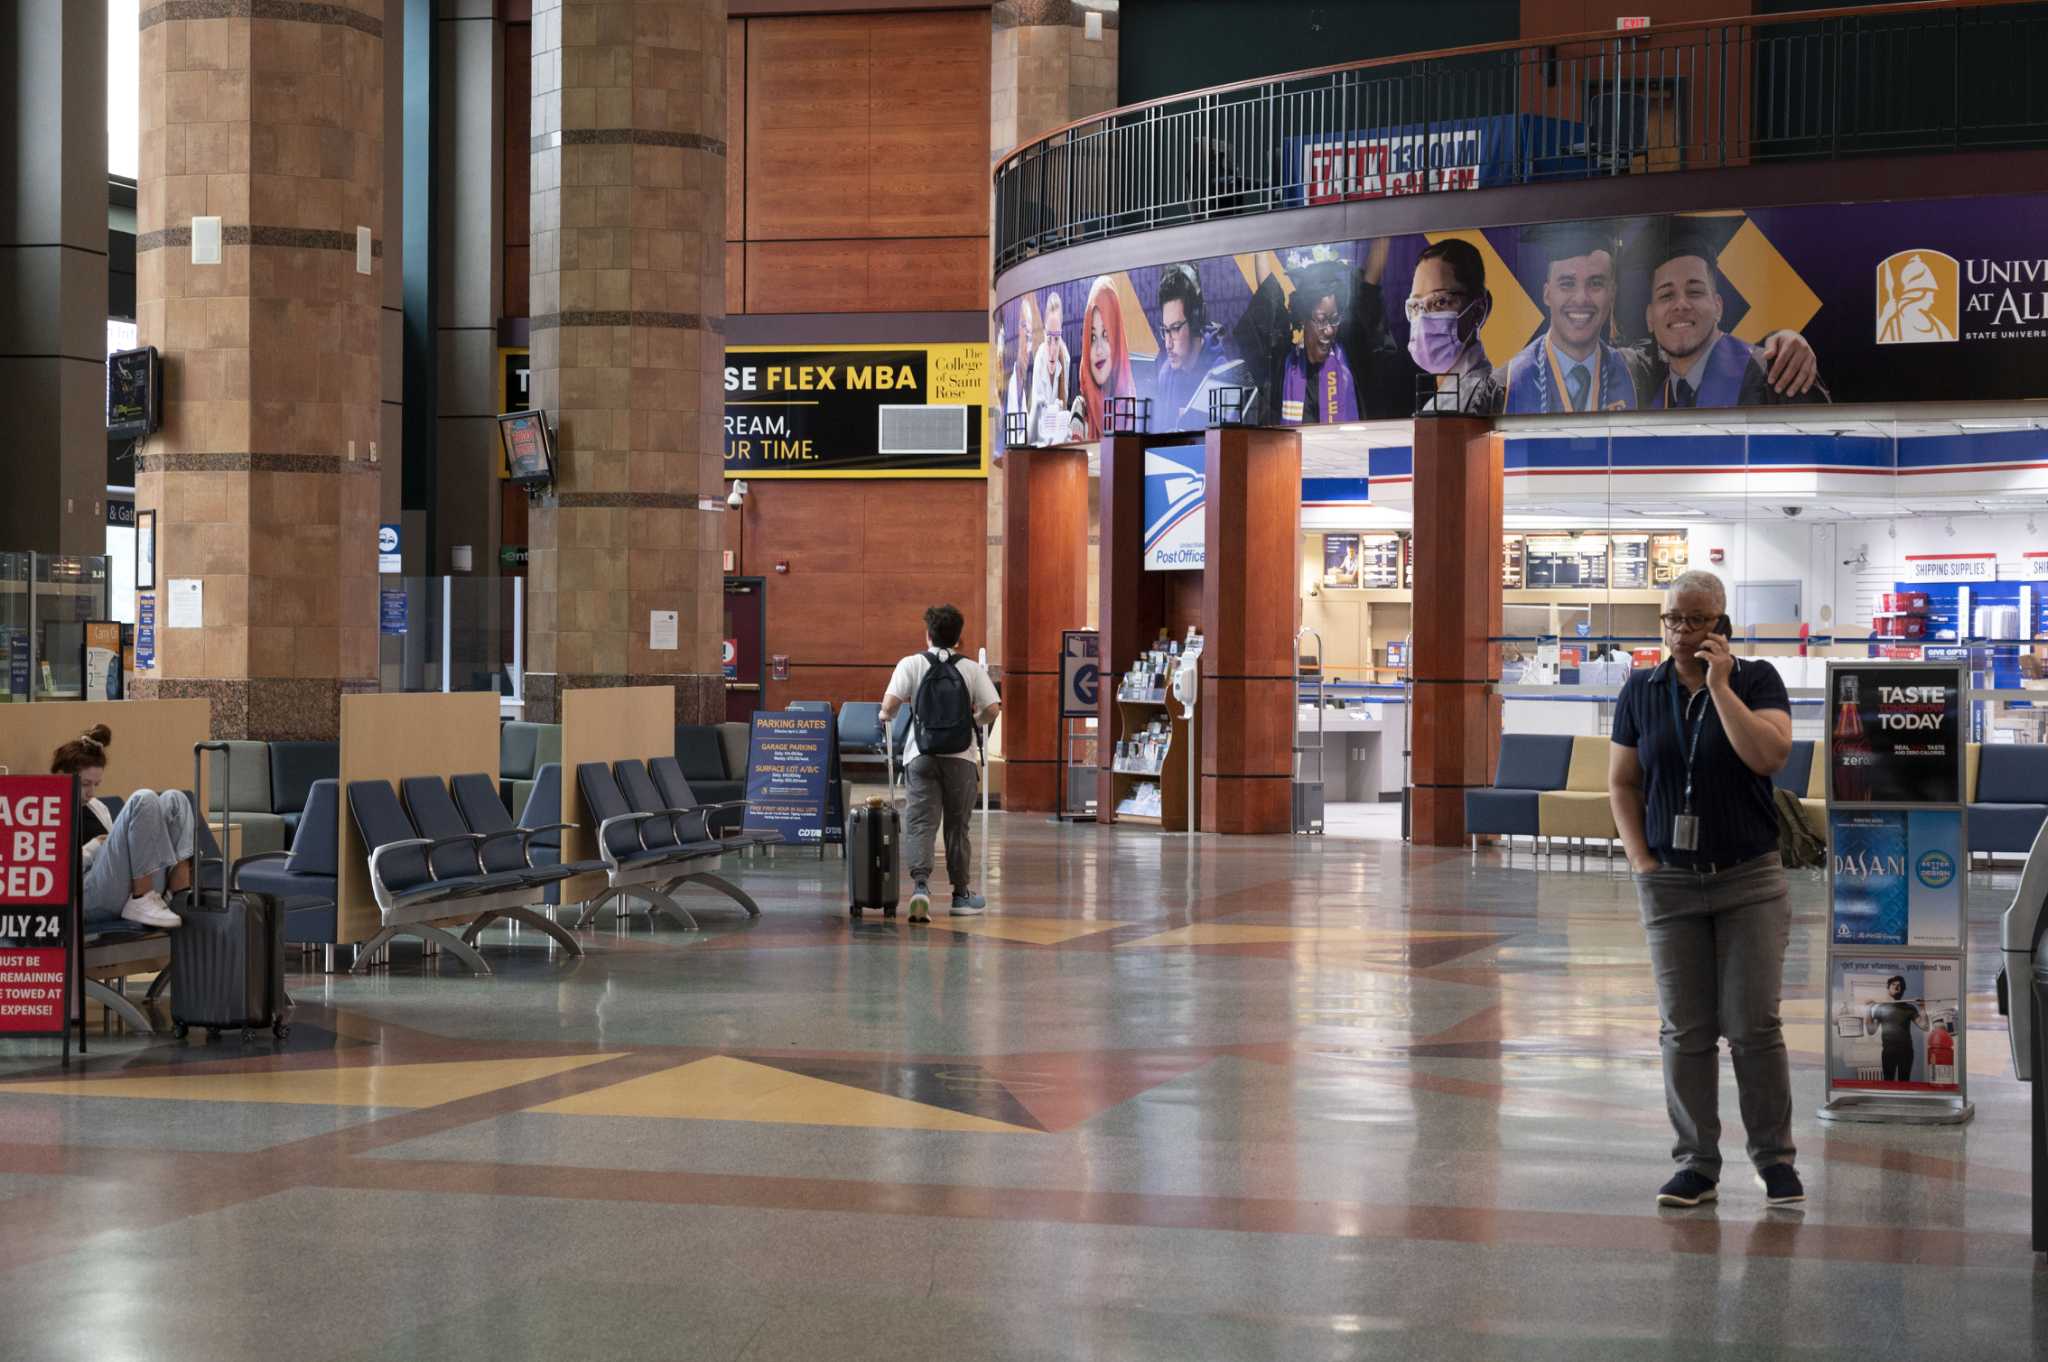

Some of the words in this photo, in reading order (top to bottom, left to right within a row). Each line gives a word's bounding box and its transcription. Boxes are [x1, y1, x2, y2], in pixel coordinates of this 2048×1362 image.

[1312, 152, 1384, 199] TALK
[1967, 293, 1994, 312] AT
[1966, 331, 1998, 339] STATE
[935, 356, 983, 376] College
[724, 367, 757, 391] SE
[767, 366, 836, 390] FLEX
[846, 365, 917, 390] MBA
[949, 374, 981, 388] Saint
[935, 385, 966, 399] Rose
[760, 440, 819, 459] TIME.
[1156, 550, 1177, 563] Post
[1178, 549, 1206, 562] Office
[1915, 564, 1949, 576] SHIPPING
[1950, 562, 1985, 575] SUPPLIES
[1878, 686, 1945, 703] TASTE
[757, 719, 795, 728] PARKING
[798, 719, 826, 729] RATES
[1878, 713, 1944, 729] TODAY
[13, 832, 56, 861] BE
[1834, 850, 1905, 879] DASANI
[0, 867, 54, 897] ED
[34, 915, 60, 937] 24
[26, 956, 40, 967] BE
[0, 972, 63, 983] REMAINING
[5, 989, 45, 999] TOWED
[48, 988, 61, 999] AT
[1, 1005, 52, 1016] EXPENSE!
